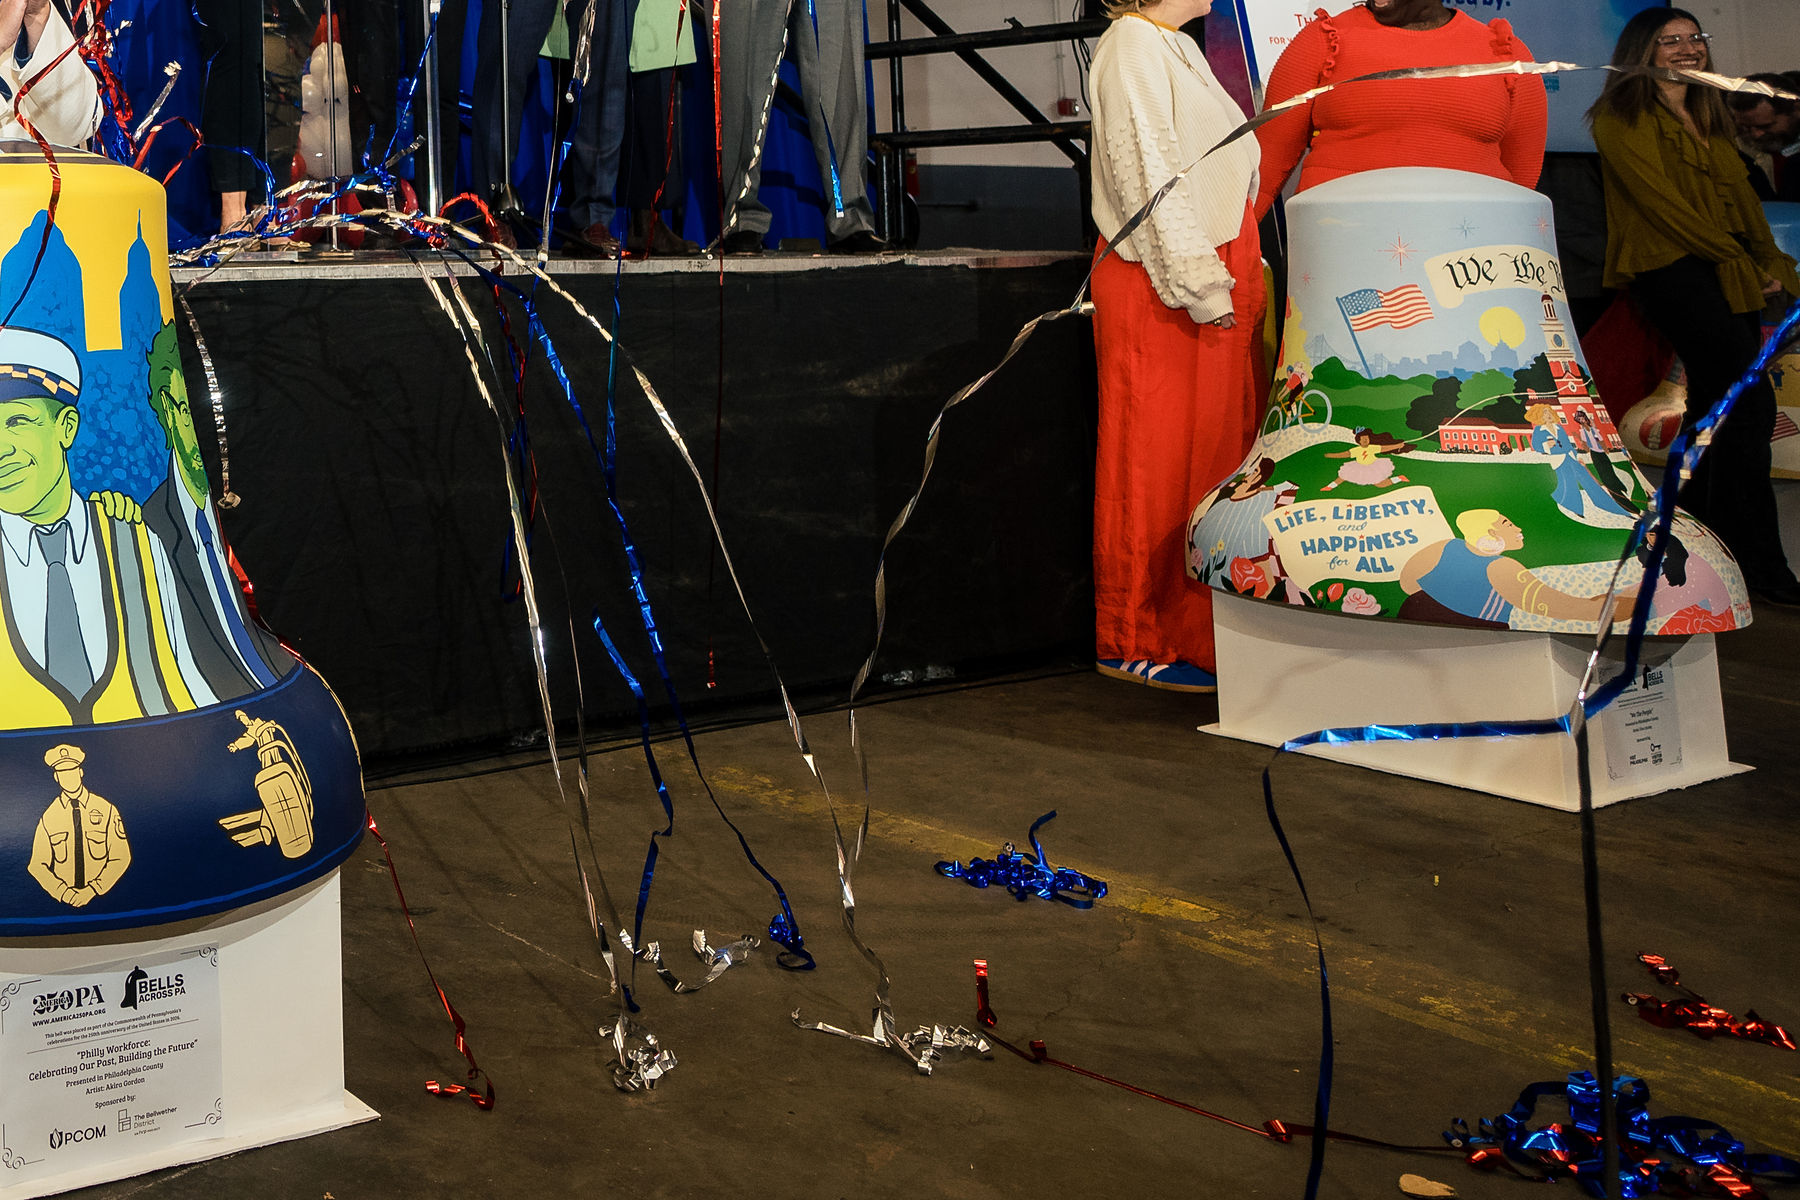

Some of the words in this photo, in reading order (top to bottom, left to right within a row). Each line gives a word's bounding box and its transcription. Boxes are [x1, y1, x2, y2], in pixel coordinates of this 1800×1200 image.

[1269, 36, 1286, 45] FOR
[1443, 253, 1499, 291] We
[1337, 521, 1368, 532] and
[1327, 556, 1350, 570] for
[1356, 556, 1394, 574] ALL
[138, 973, 184, 994] BELLS
[138, 989, 174, 1003] ACROSS
[174, 987, 186, 996] PA
[32, 1008, 106, 1027] WWW.AMERICA250PA.ORG
[106, 1039, 151, 1054] Workforce:
[28, 1065, 78, 1081] Celebrating
[79, 1062, 95, 1071] Our
[96, 1057, 117, 1068] Past,
[118, 1050, 153, 1064] Building
[154, 1047, 167, 1057] the
[65, 1076, 97, 1087] Presented
[104, 1067, 142, 1080] Philadelphia
[142, 1062, 164, 1073] County
[85, 1085, 105, 1095] Artist:
[105, 1082, 122, 1091] Akira
[123, 1077, 145, 1087] Gordon
[95, 1095, 126, 1109] Sponsored
[126, 1094, 136, 1103] by:
[65, 1125, 106, 1145] PCOM
